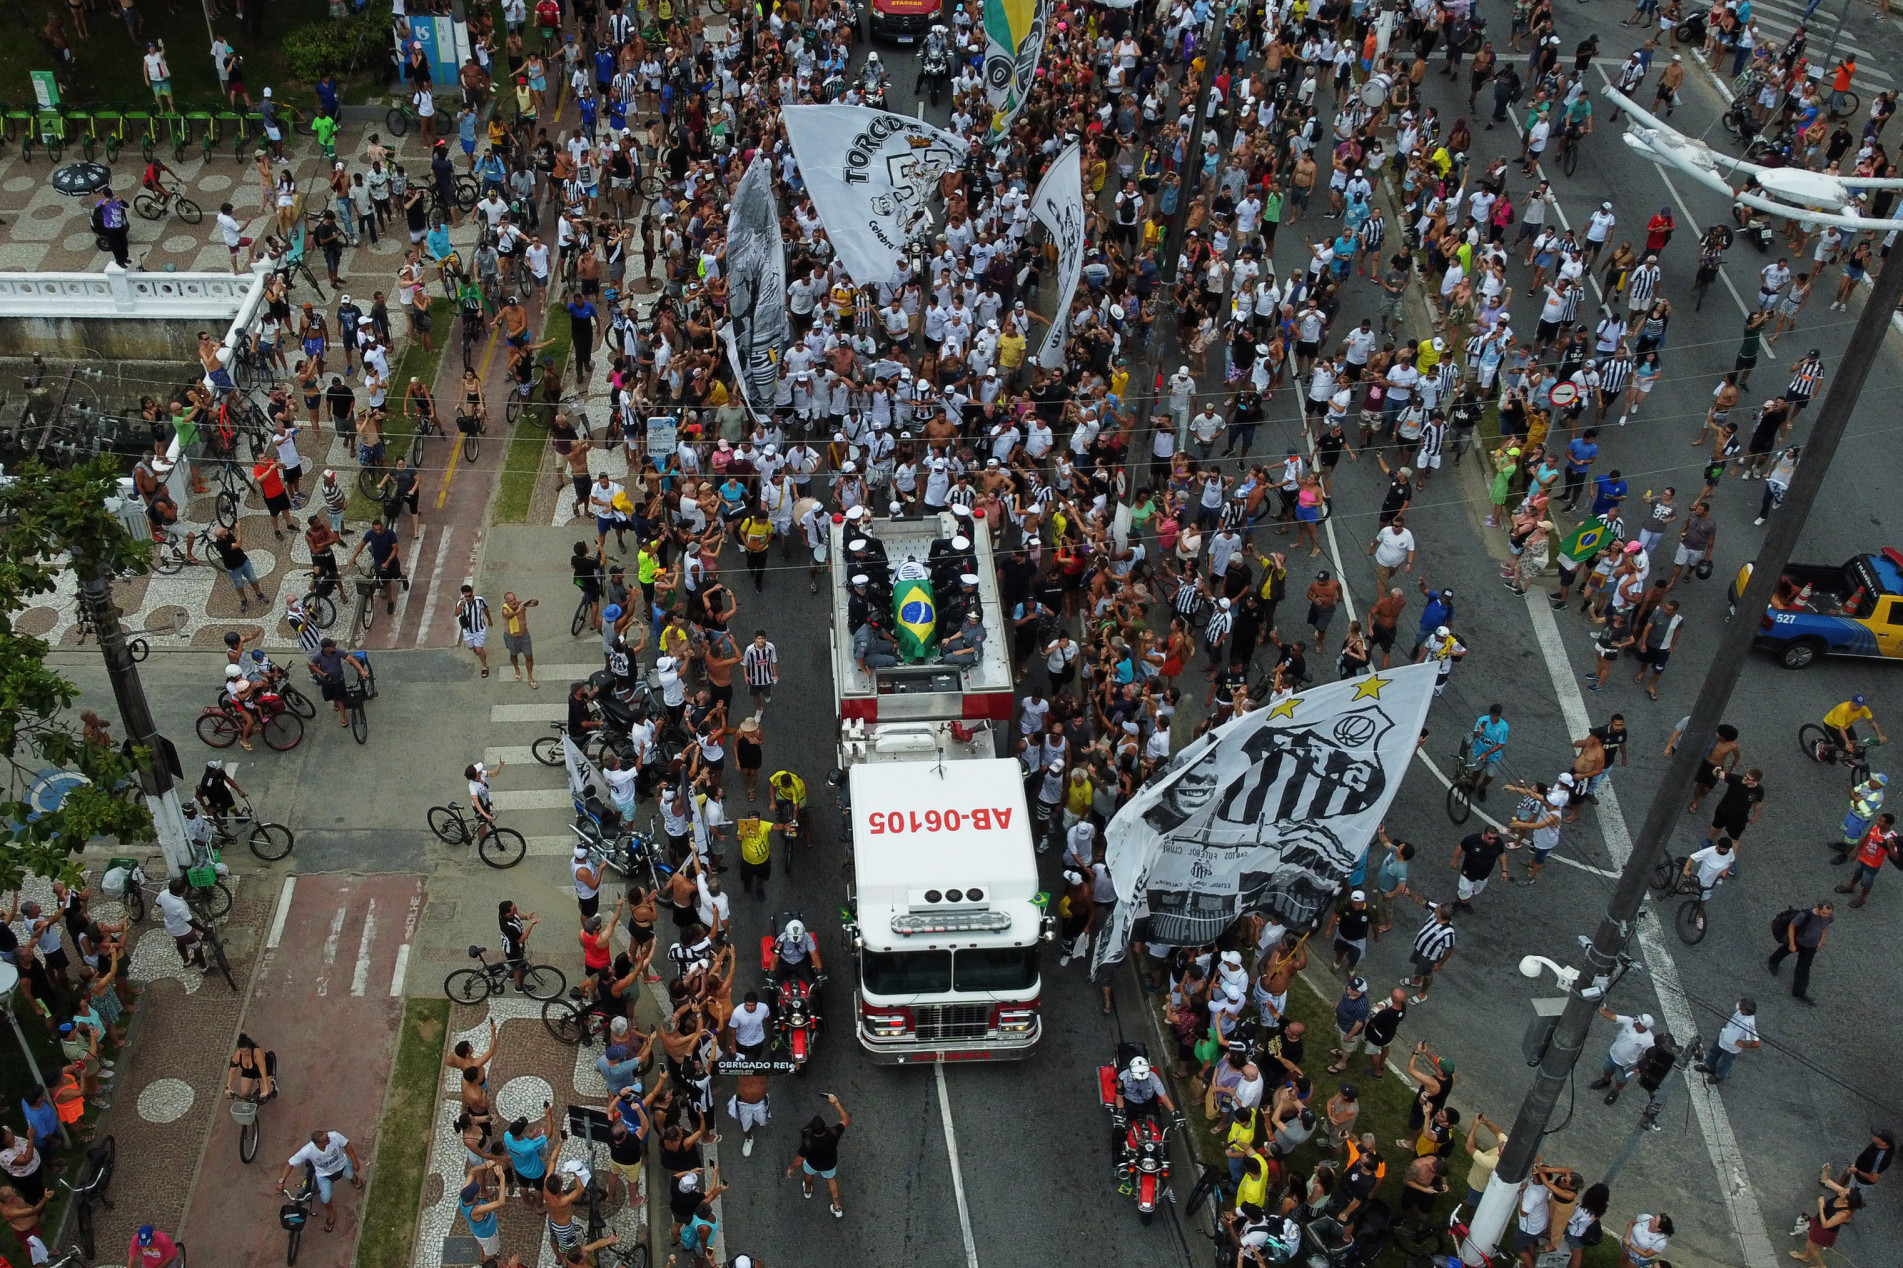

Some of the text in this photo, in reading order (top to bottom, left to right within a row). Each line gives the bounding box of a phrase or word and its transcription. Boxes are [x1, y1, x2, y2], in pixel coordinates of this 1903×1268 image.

[1653, 508, 1669, 521] 92
[1776, 613, 1796, 624] 527
[869, 808, 1012, 834] AB-06105
[754, 840, 768, 858] 10
[718, 1061, 789, 1069] OBRIGADO REI
